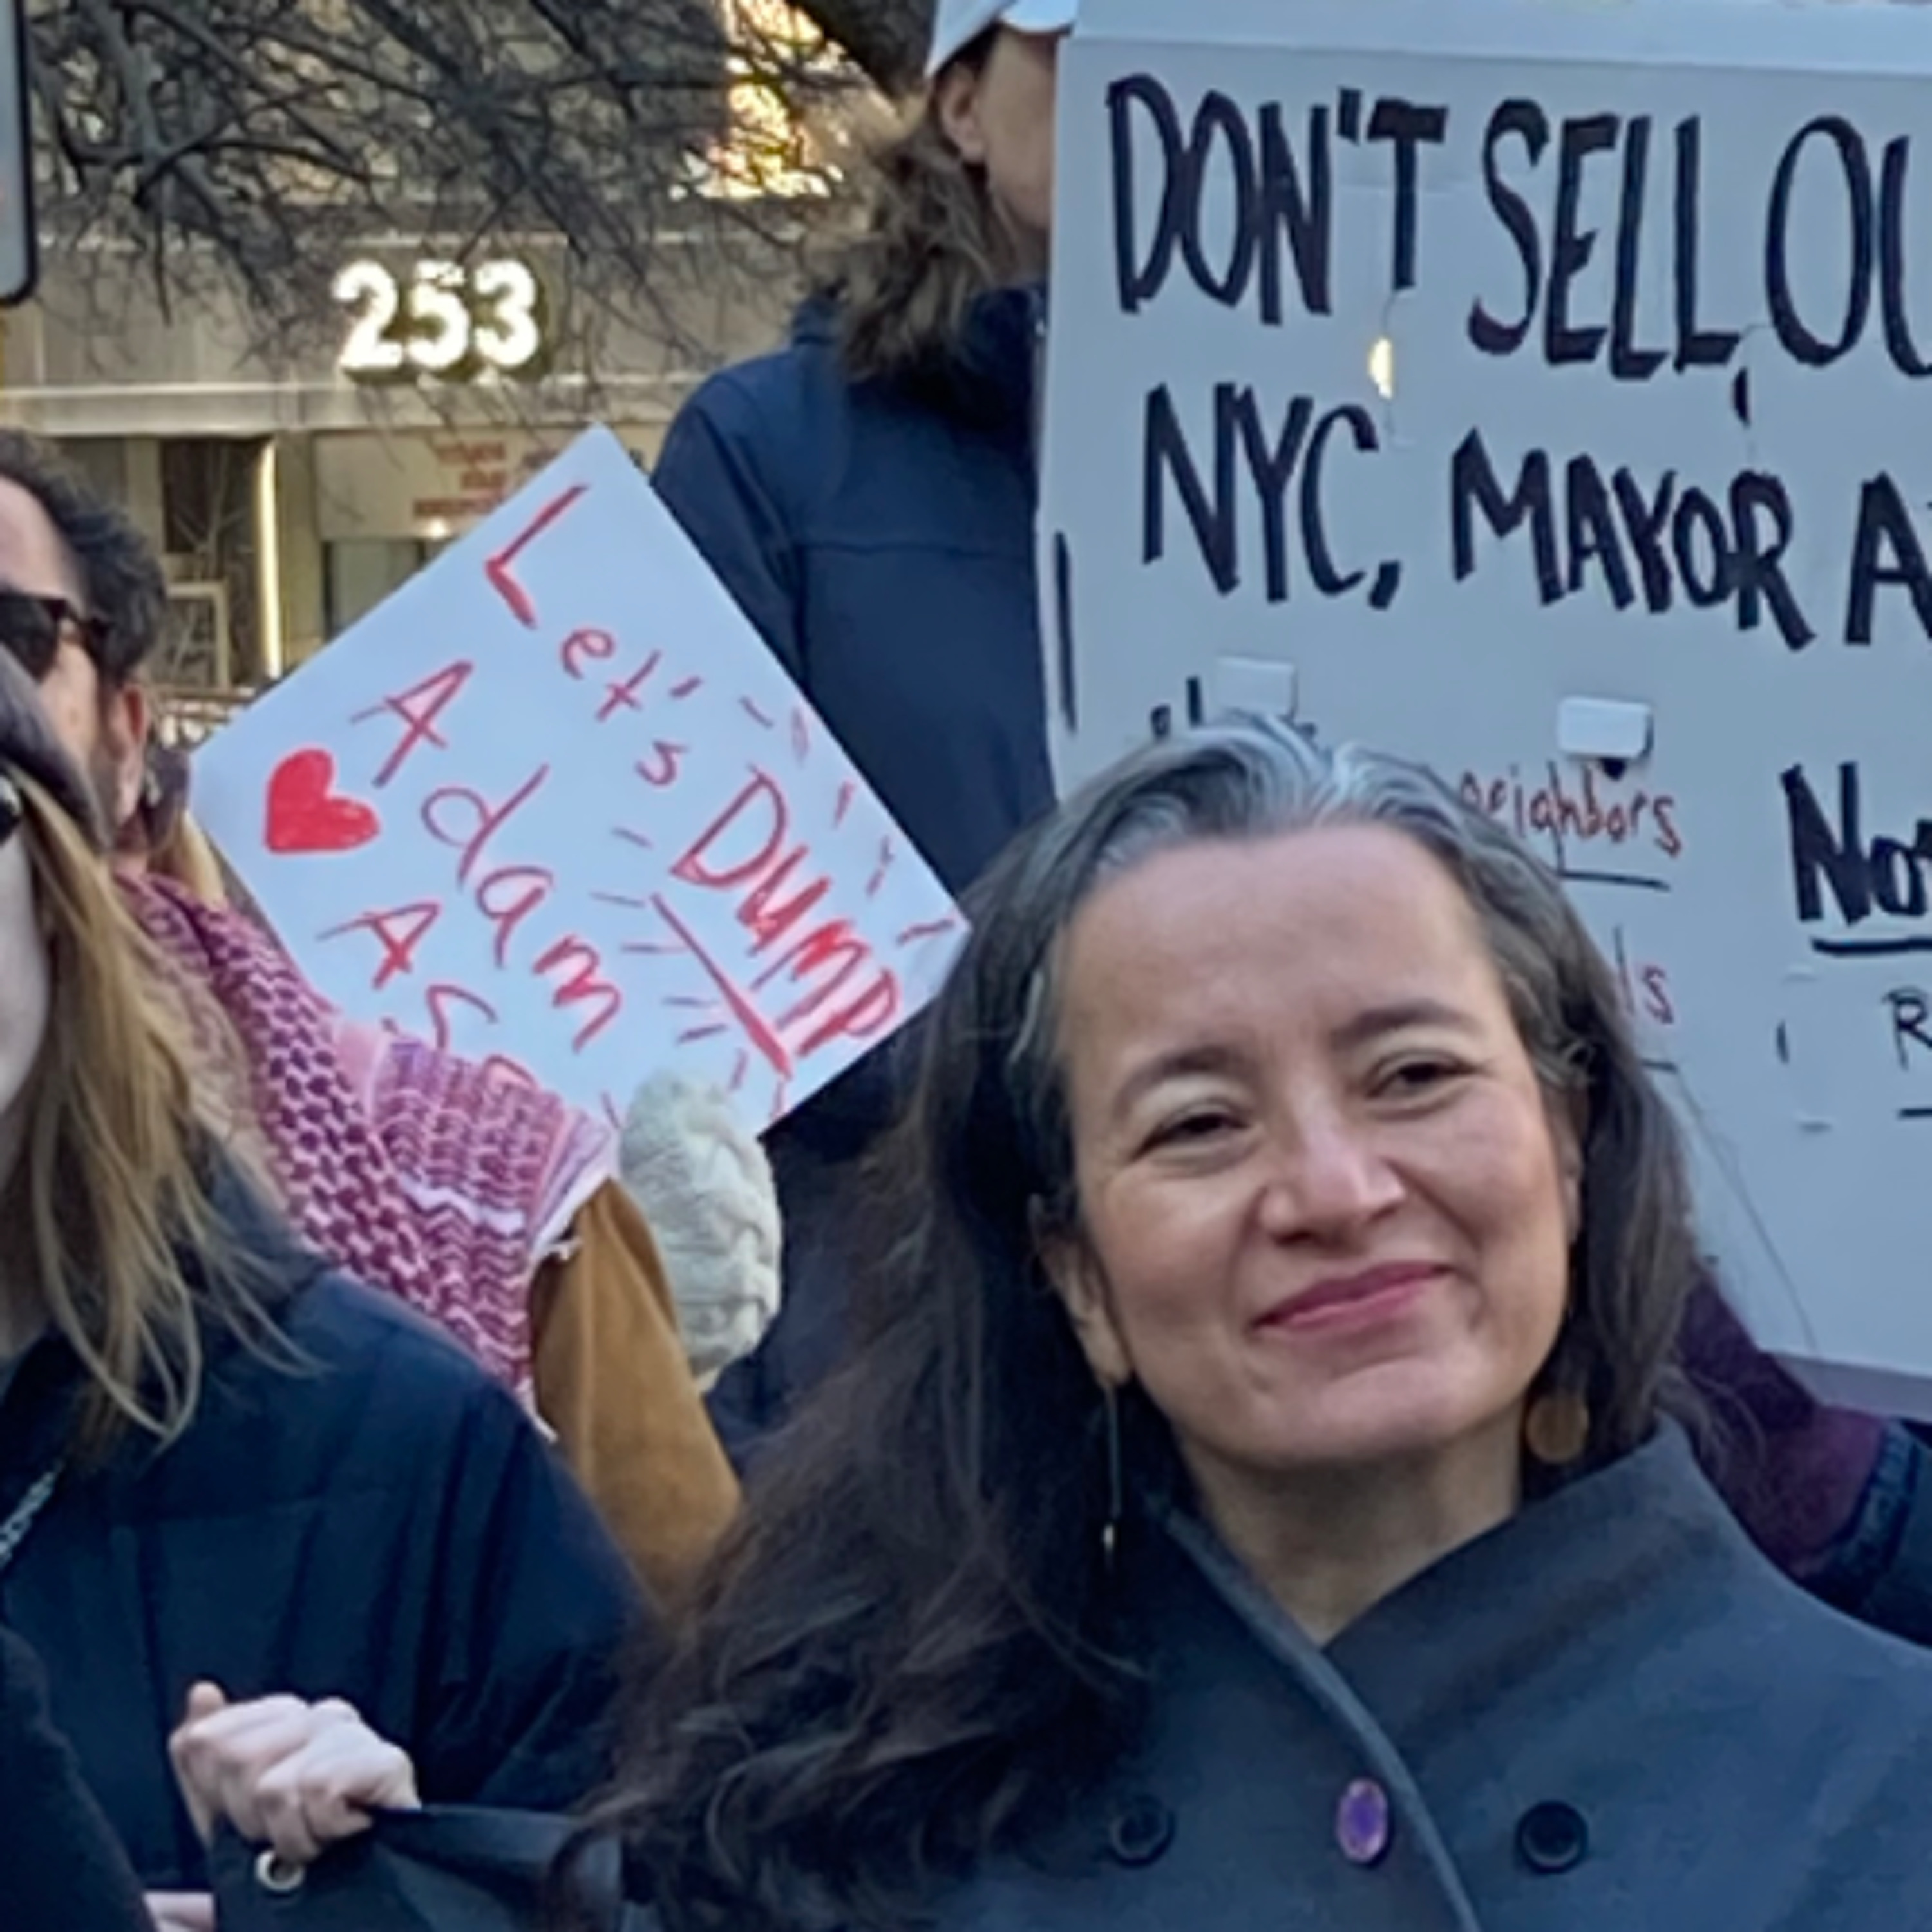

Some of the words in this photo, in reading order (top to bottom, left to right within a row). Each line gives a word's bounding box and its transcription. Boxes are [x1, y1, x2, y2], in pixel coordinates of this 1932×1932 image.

[332, 260, 540, 370] 253
[1106, 73, 1449, 326] DON'T
[1467, 98, 1743, 381] SELL
[1142, 382, 1401, 611] NYC,
[1451, 426, 1817, 652] MAYOR
[483, 484, 707, 788] Let's
[670, 765, 902, 1060] DUMP
